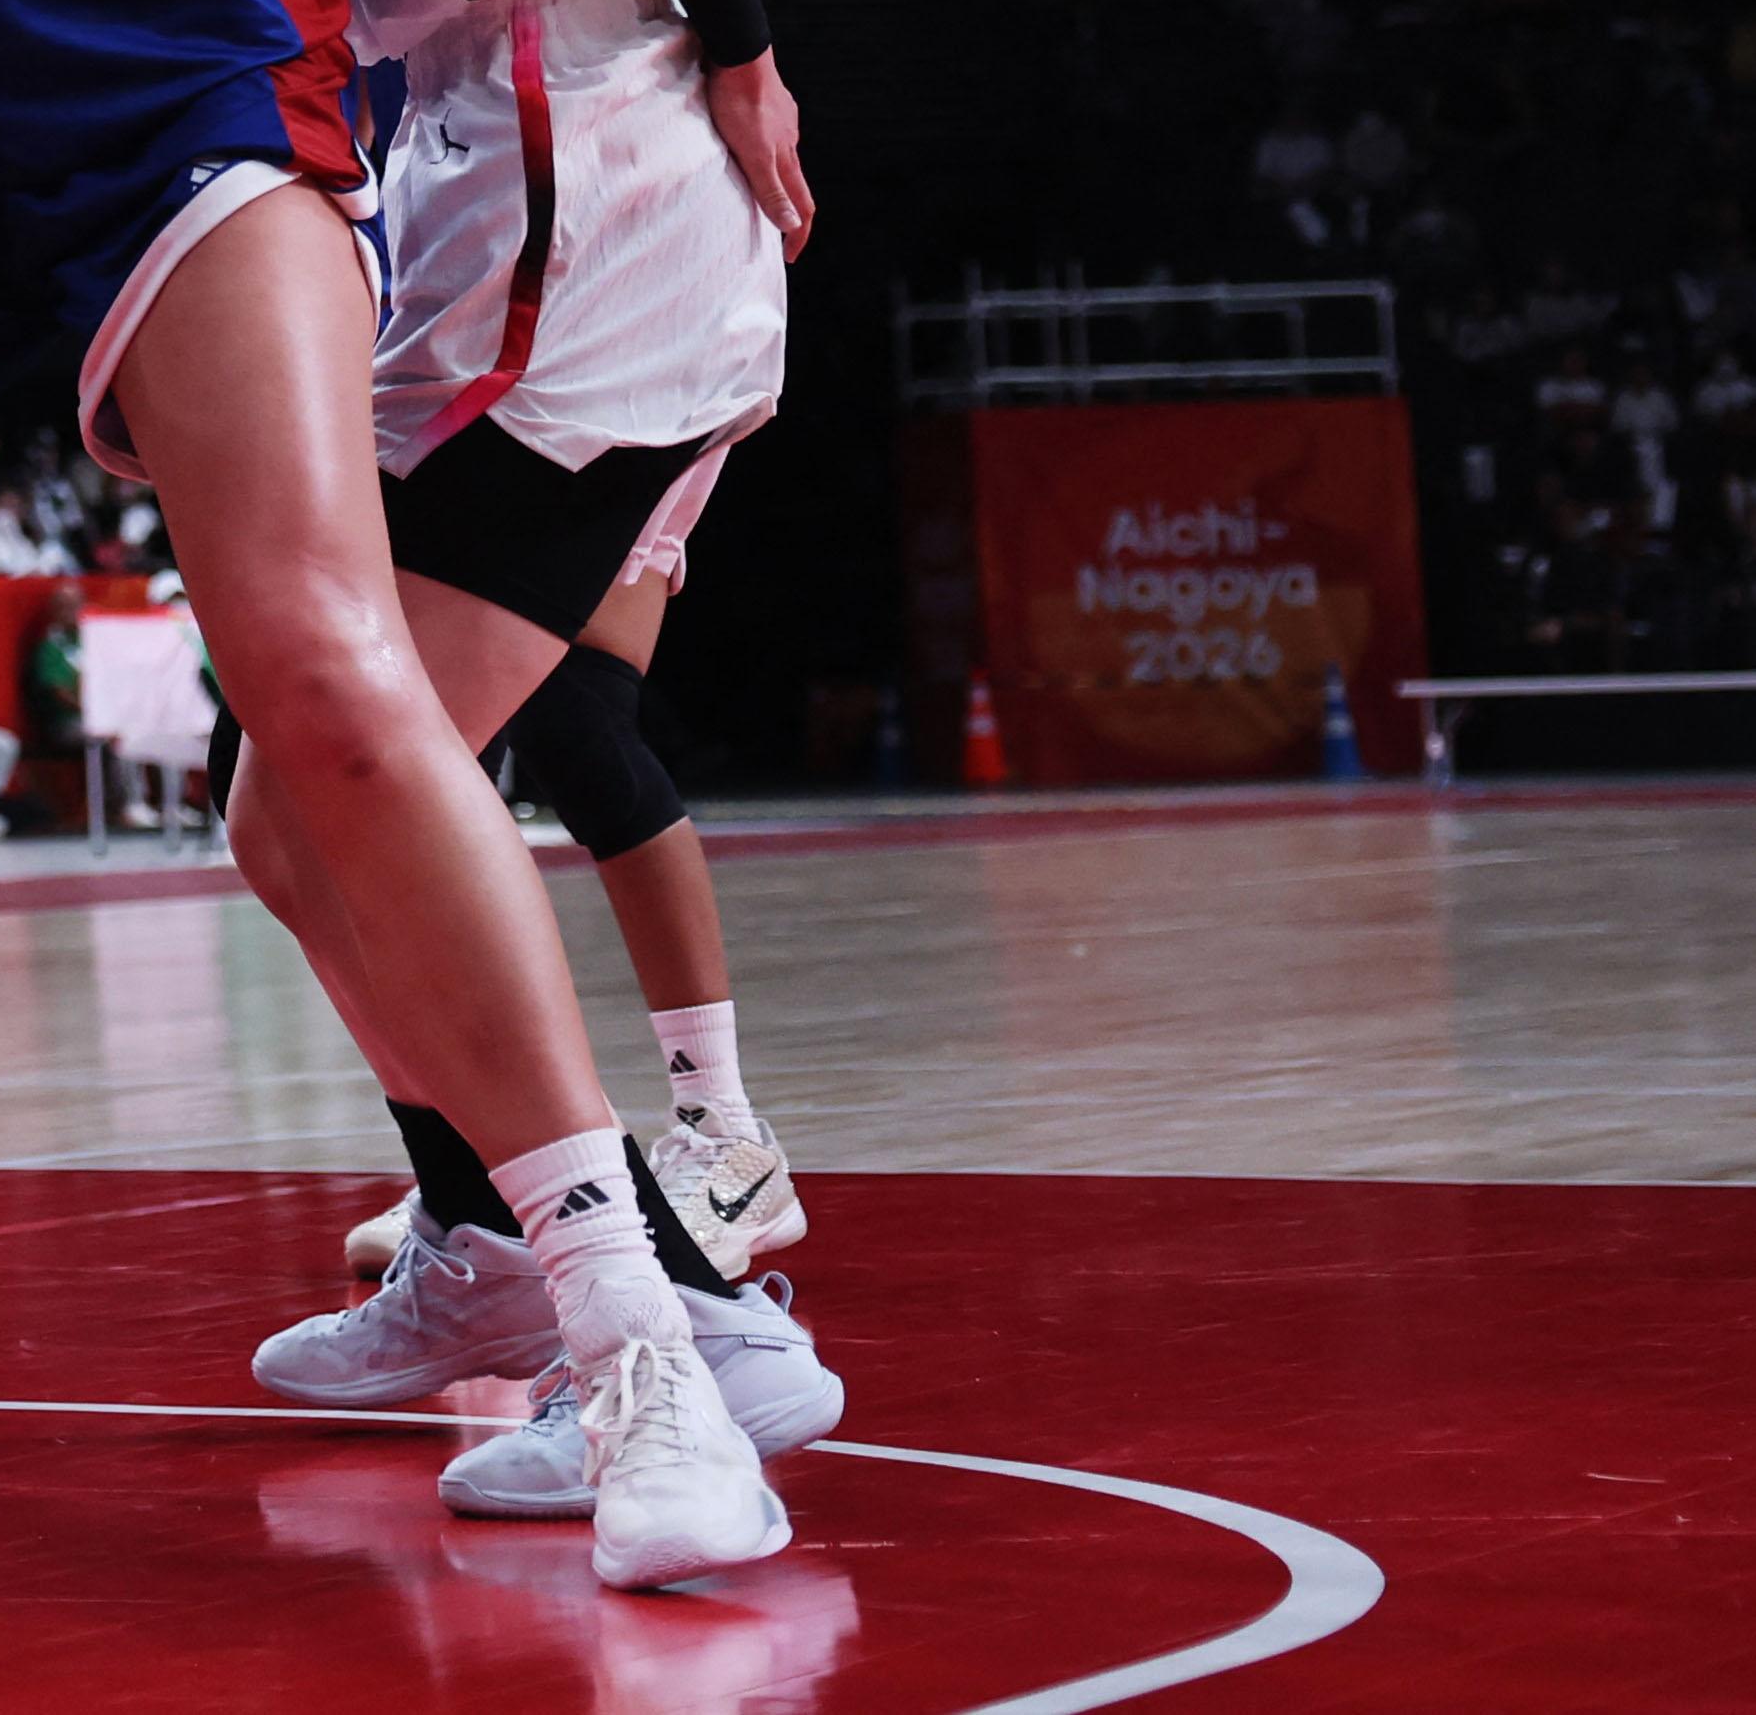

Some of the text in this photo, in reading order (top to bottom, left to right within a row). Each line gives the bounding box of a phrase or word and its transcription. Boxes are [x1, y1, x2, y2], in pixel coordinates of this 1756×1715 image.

[1103, 496, 1287, 559] Aichi-
[1075, 560, 1319, 623] Nagoya
[1122, 626, 1284, 682] 2026
